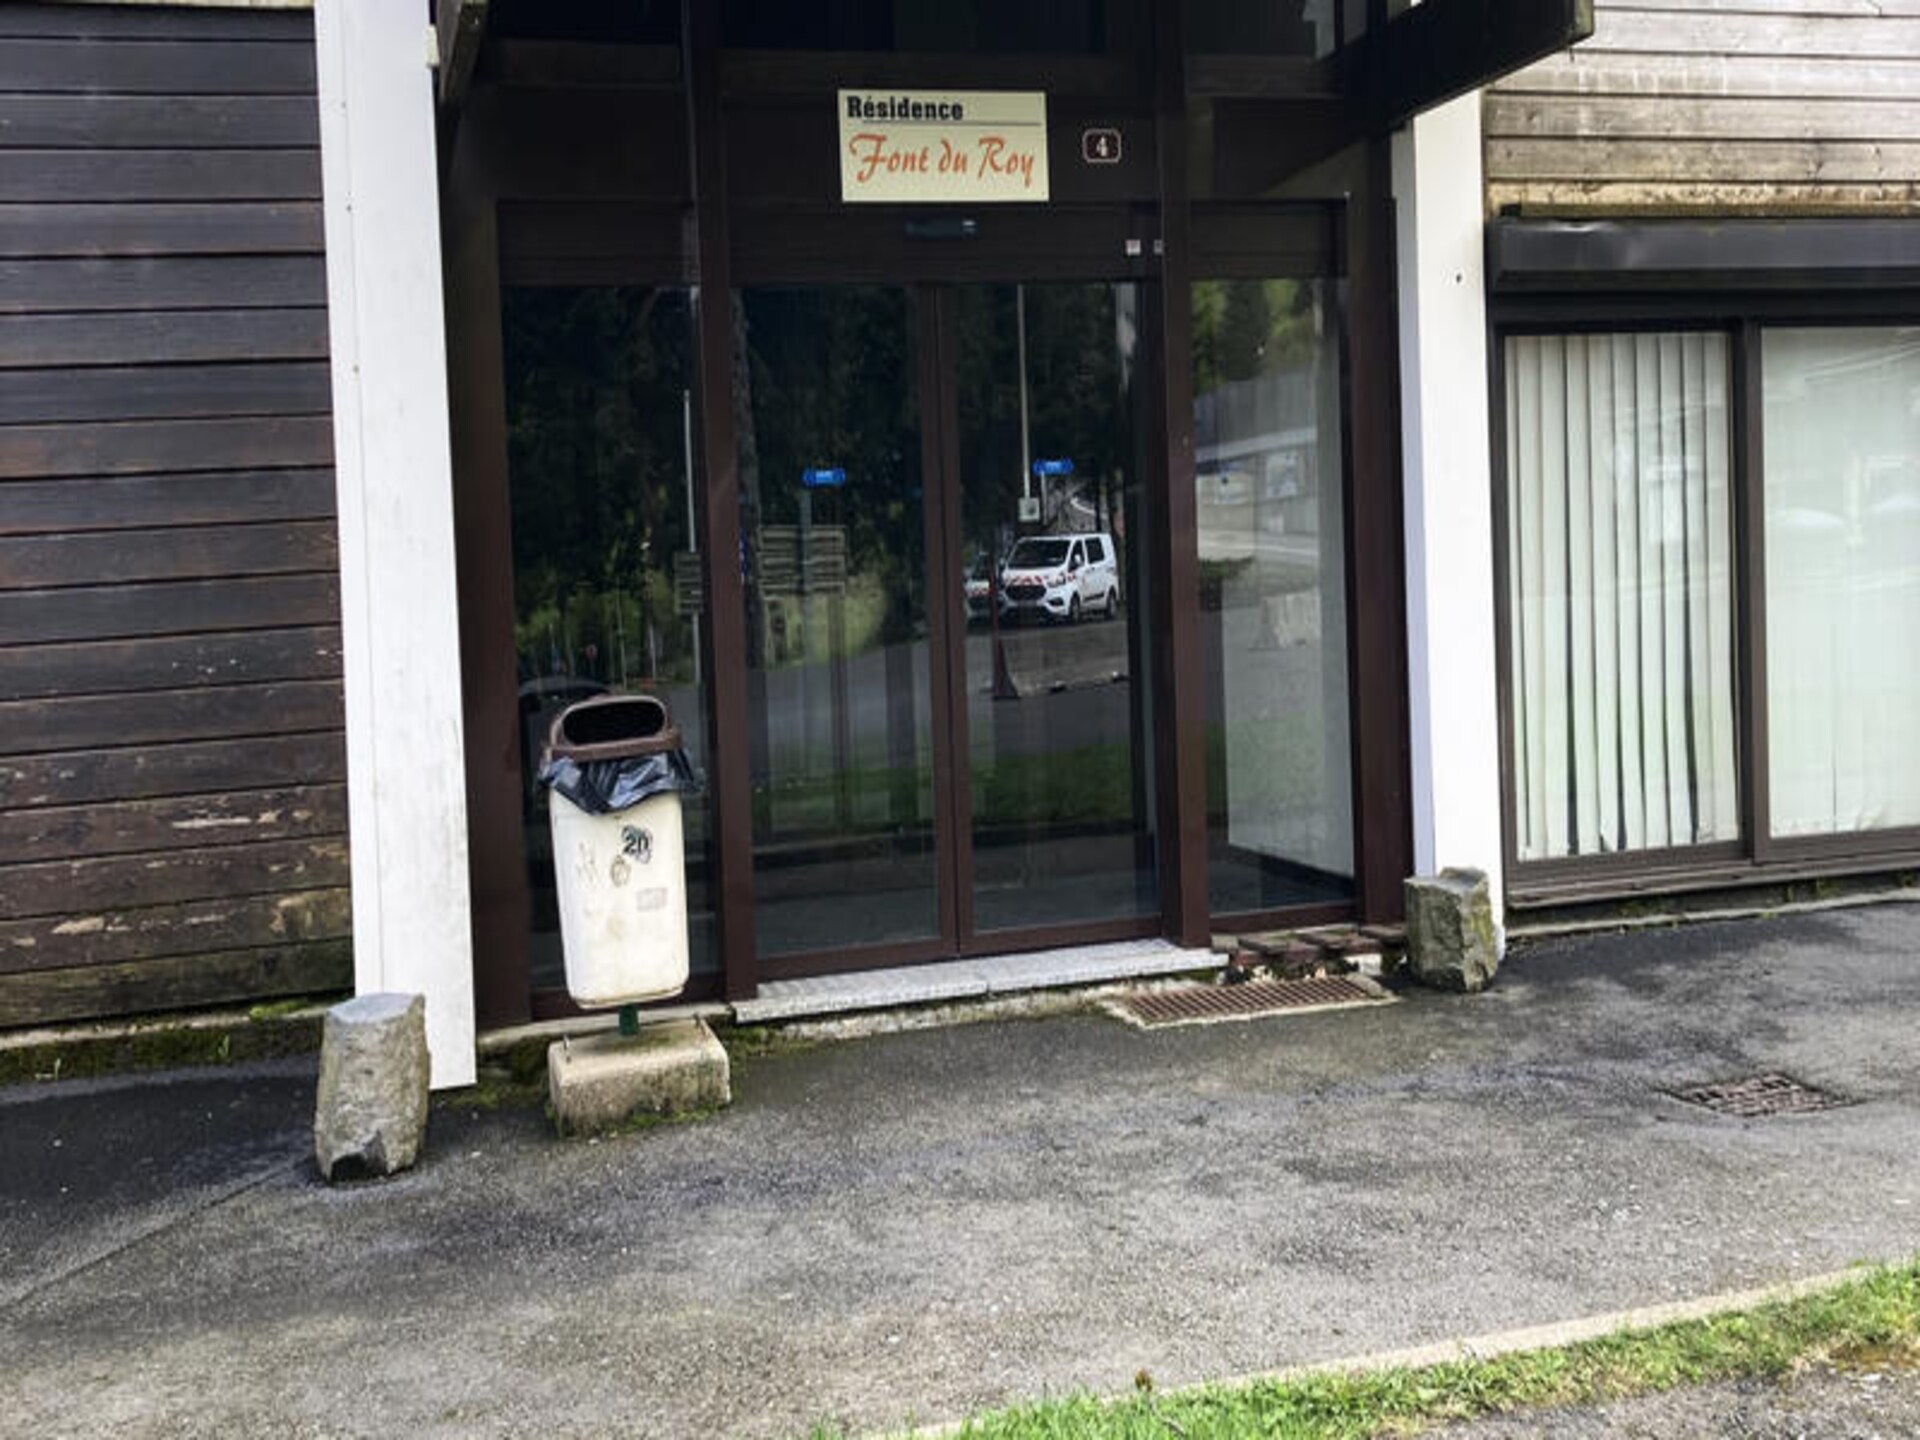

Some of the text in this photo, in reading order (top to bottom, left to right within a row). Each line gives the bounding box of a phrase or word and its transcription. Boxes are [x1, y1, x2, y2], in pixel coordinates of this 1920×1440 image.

[847, 95, 963, 120] Résidence
[1096, 136, 1107, 157] 4
[849, 133, 1034, 187] Font du Roy
[621, 833, 650, 855] 20
